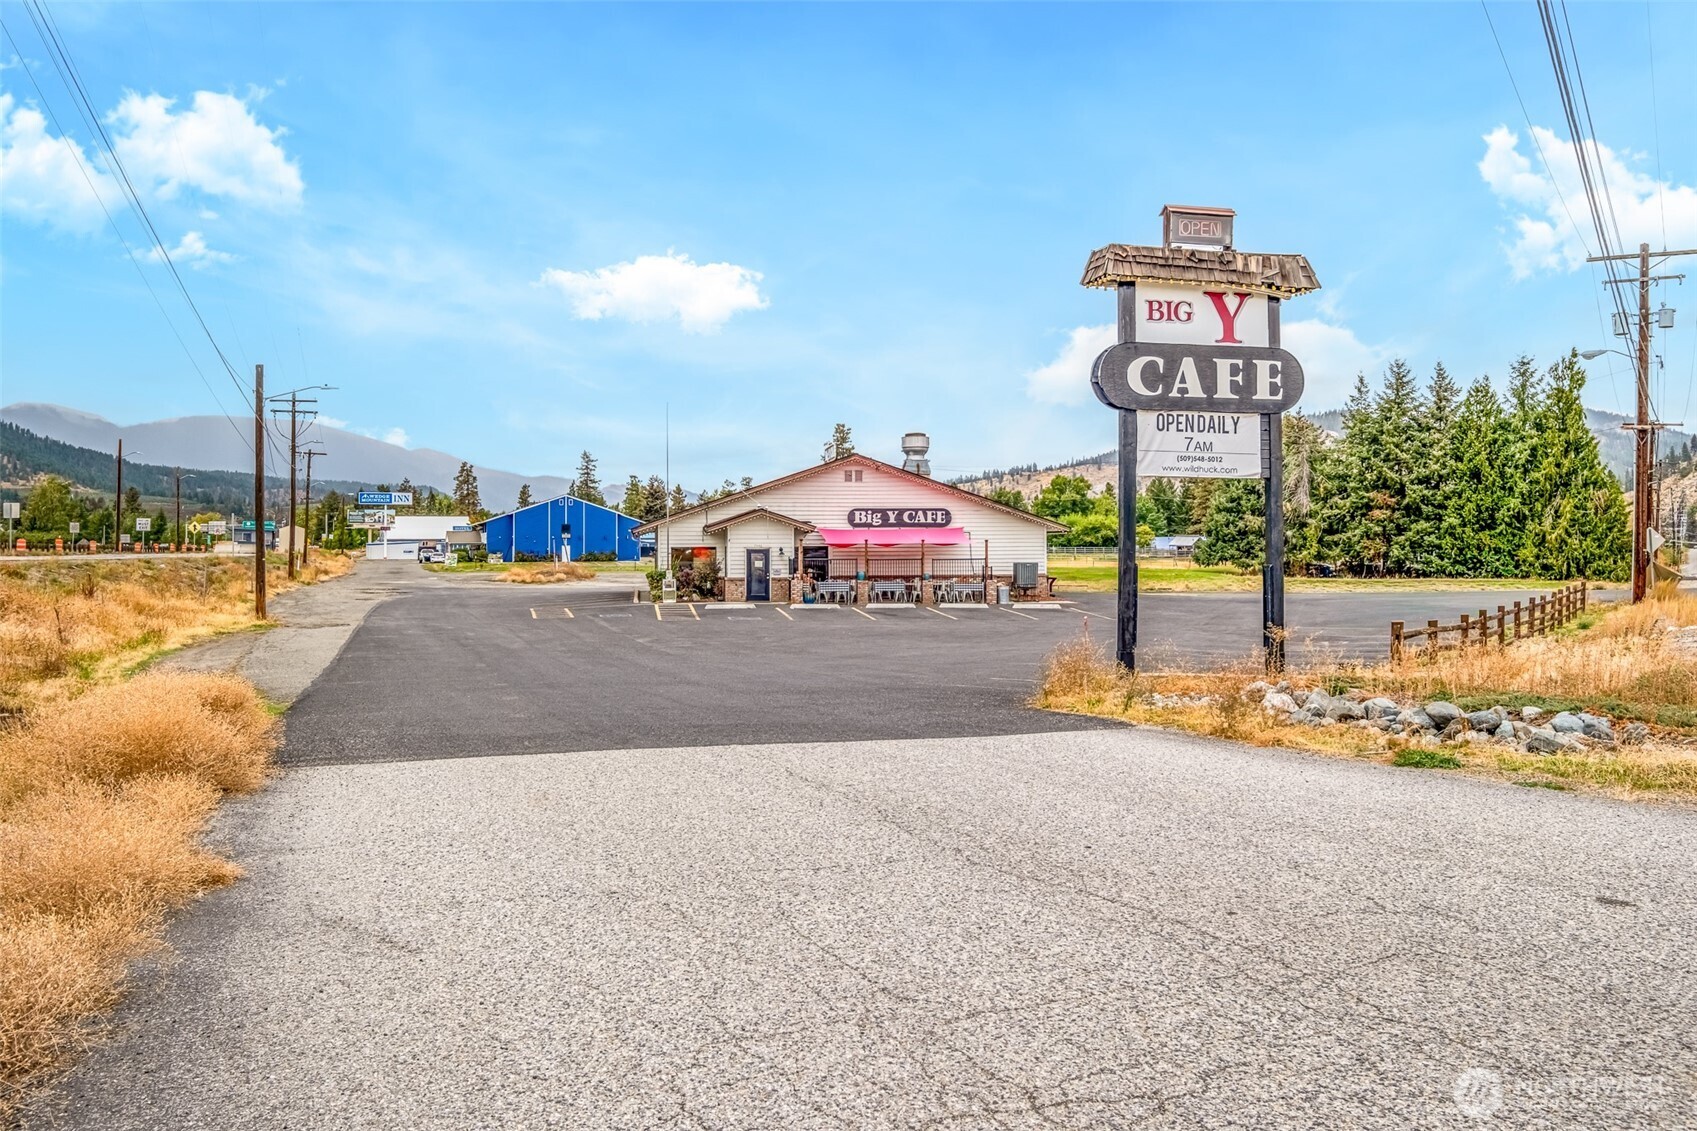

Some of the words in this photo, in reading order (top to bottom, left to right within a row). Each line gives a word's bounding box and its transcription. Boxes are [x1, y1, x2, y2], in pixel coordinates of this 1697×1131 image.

[1180, 220, 1221, 237] OPEN
[1146, 300, 1193, 322] BIG
[1203, 291, 1252, 344] Y
[1126, 355, 1284, 400] CAFE
[1161, 464, 1238, 475] www.wildhuck.com
[393, 494, 411, 503] INN
[853, 510, 882, 526] Big
[886, 510, 899, 524] Y
[902, 510, 947, 524] CAFE
